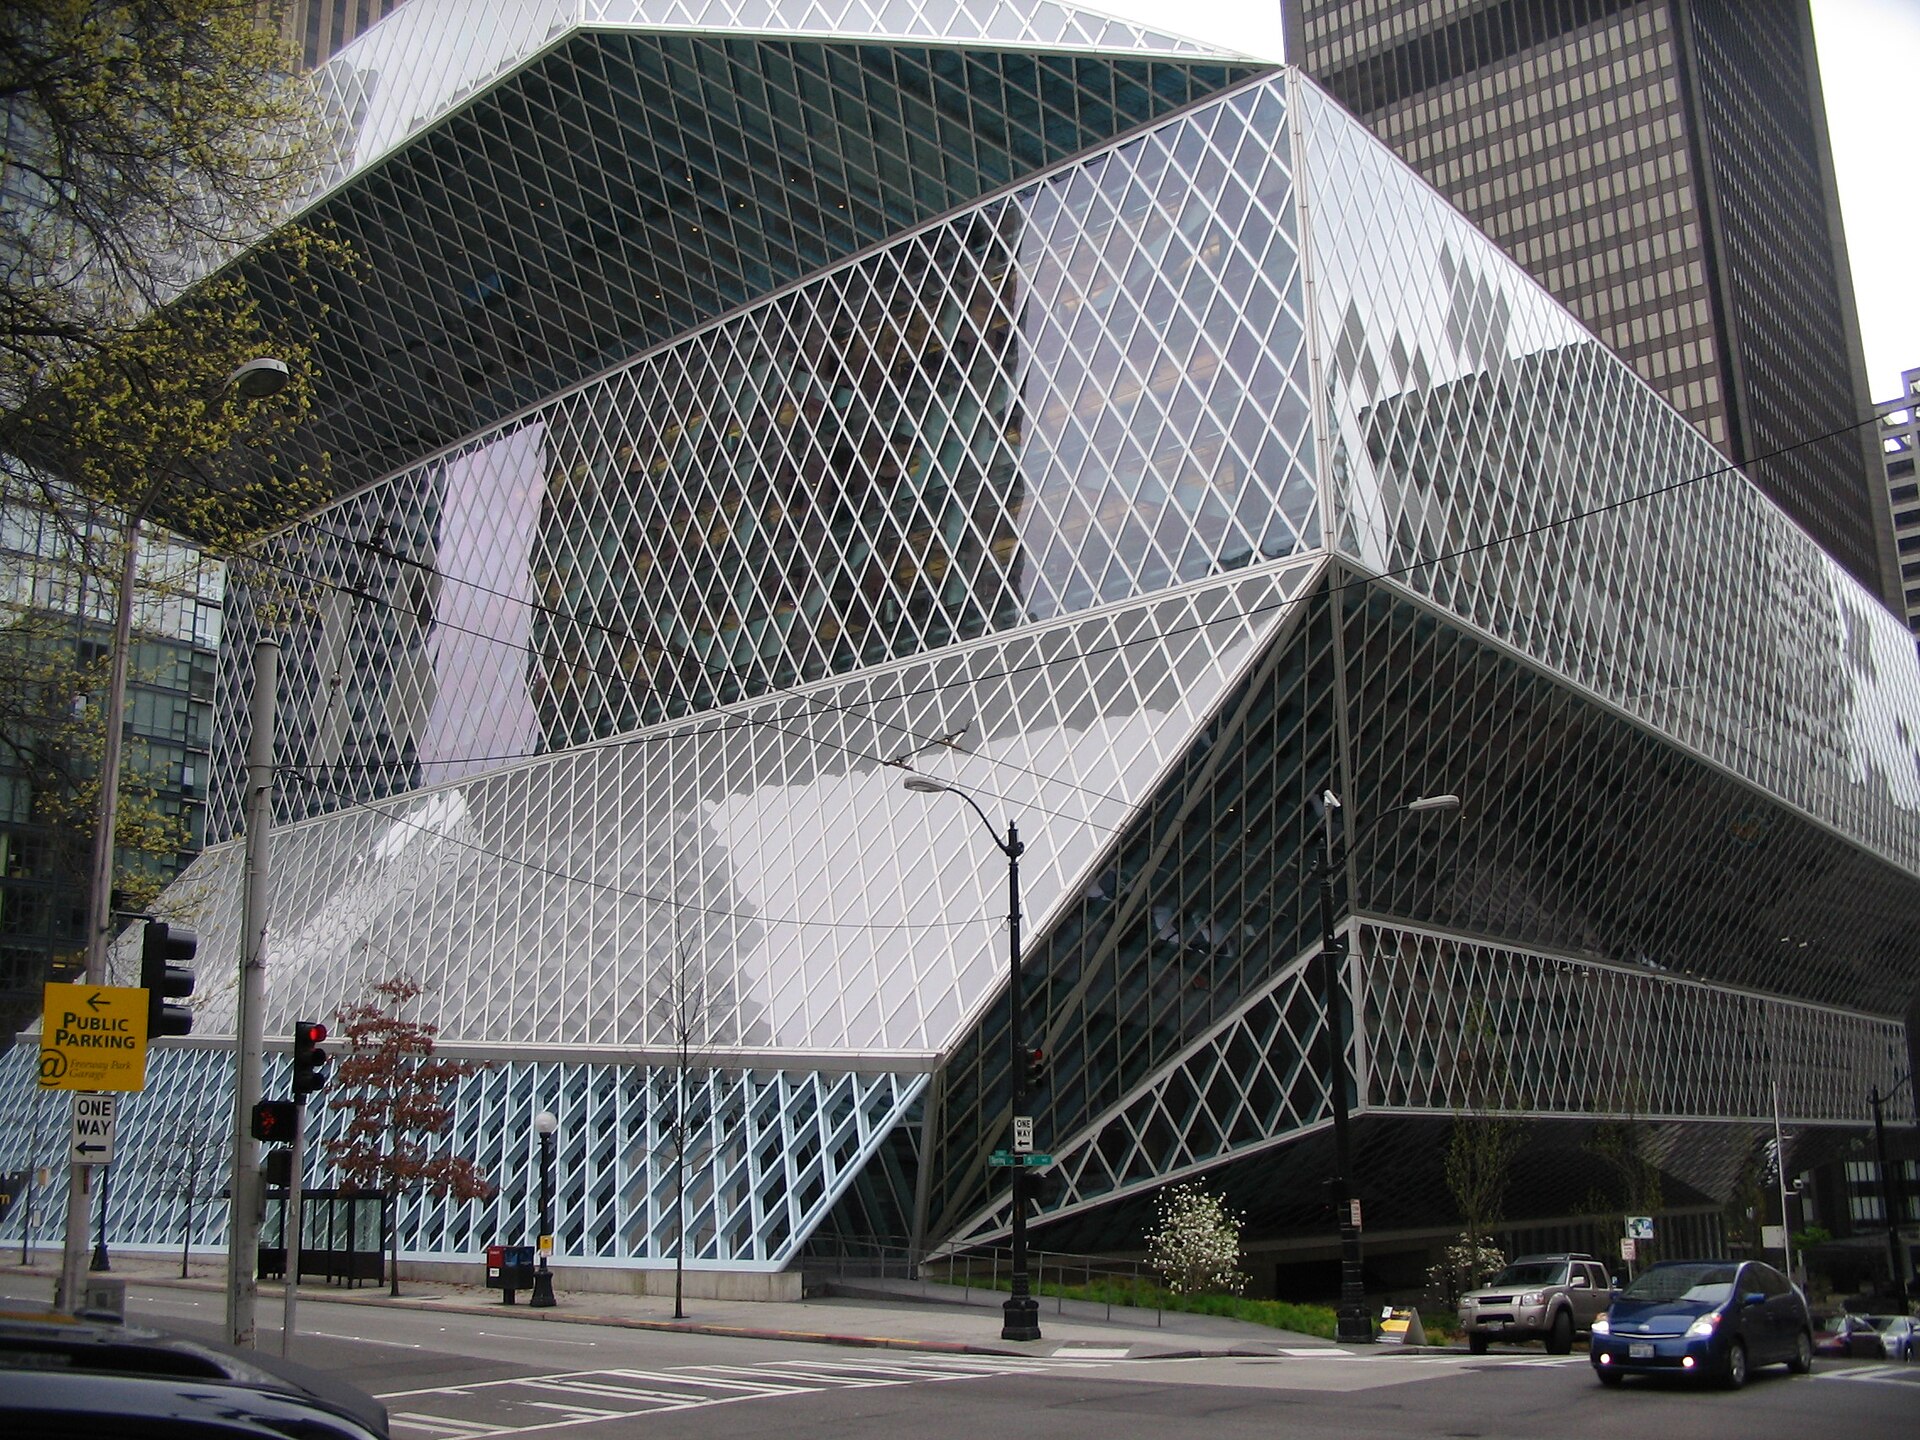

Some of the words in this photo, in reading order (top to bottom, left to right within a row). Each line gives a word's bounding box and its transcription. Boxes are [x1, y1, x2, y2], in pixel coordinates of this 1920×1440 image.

[63, 1012, 129, 1032] PUBLIC
[55, 1029, 136, 1049] PARKING
[111, 1060, 131, 1070] Park
[69, 1069, 106, 1081] Garage
[78, 1099, 112, 1117] ONE
[77, 1119, 112, 1136] WAY
[1016, 1120, 1031, 1128] ONE
